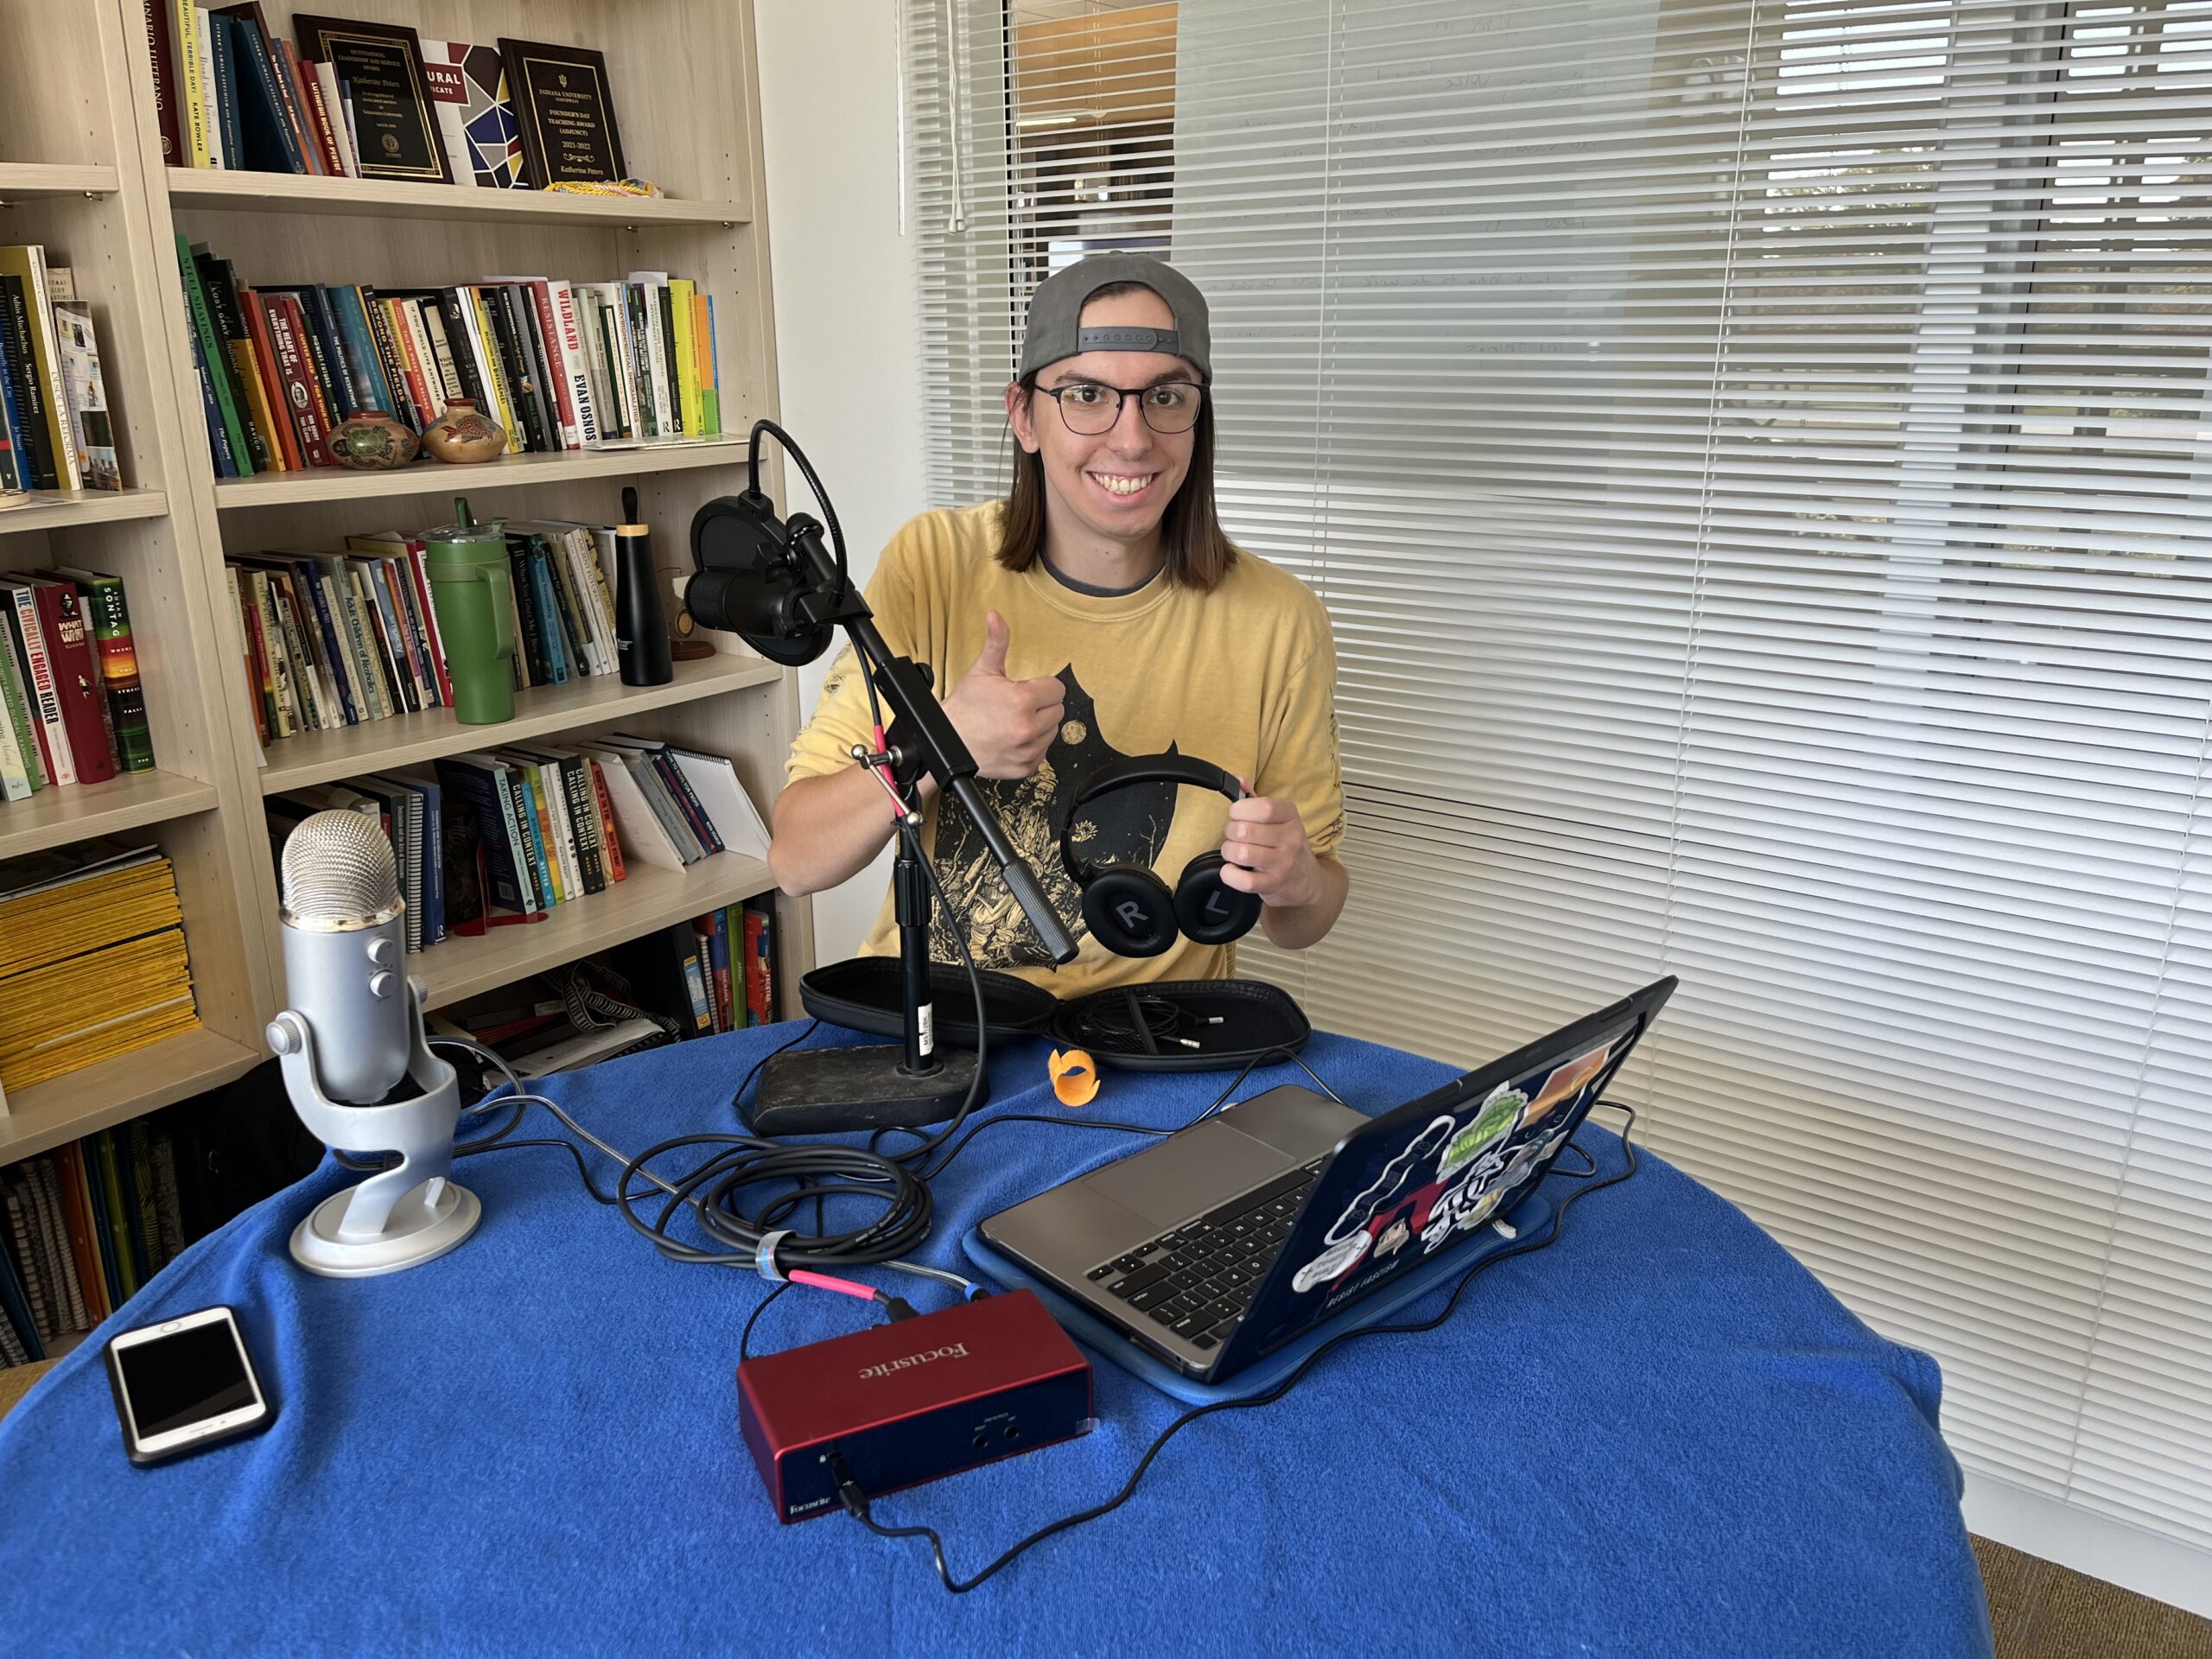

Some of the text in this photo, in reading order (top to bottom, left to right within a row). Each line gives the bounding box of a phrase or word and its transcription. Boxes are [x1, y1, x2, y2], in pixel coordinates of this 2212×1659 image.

[186, 42, 194, 73] TERRIBLE
[550, 110, 579, 118] FOUNDER'S
[562, 91, 592, 100] UNIVERSITY
[326, 135, 333, 145] OF
[548, 118, 575, 127] TEACHING
[560, 128, 588, 137] (ADJUNCT)
[562, 141, 591, 150] 2021-2022
[211, 287, 221, 309] LOST
[17, 315, 28, 353] Muchachos
[194, 296, 212, 348] SHAVINGS
[542, 298, 561, 367] RESISTANCE
[558, 289, 578, 350] WILDLAND
[269, 309, 292, 375] EVERYTHING THAT IS
[278, 317, 297, 364] THE HEART OF
[312, 334, 323, 362] MIDWEST
[371, 300, 404, 402] BEYOND THE FIELDS
[299, 333, 309, 357] CUSTER
[306, 358, 314, 374] DIED
[318, 399, 326, 417] YOUR
[336, 346, 345, 369] POLITICS
[344, 376, 357, 408] RESENTMENT
[417, 329, 426, 350] COULD
[428, 367, 440, 401] ANYWHERE
[618, 304, 630, 369] ENVIRONMENTAL
[628, 372, 638, 422] INEQUALITIES
[23, 362, 40, 414] Sergio Ramírez
[51, 371, 74, 464] DESDE LA REFORMA
[574, 374, 596, 441] EVAN OSNOS
[14, 433, 24, 451] Stuart
[249, 421, 260, 450] DAVICH
[518, 560, 527, 582] When
[577, 537, 599, 603] ANCIENT FUTURES
[102, 587, 121, 636] SONTAG
[112, 591, 123, 617] SUSAN
[257, 581, 265, 601] THE
[261, 602, 273, 642] PROPHET
[524, 598, 532, 617] Greet
[58, 620, 82, 631] WHAT
[387, 615, 403, 653] simplicity
[527, 619, 535, 631] Me
[16, 590, 58, 724] THE CIVICALLY ENGAGED READER
[344, 596, 376, 693] Adult Children of Alcoholics
[275, 677, 284, 702] GIBRAN
[665, 750, 674, 763] HOW
[671, 762, 678, 770] TO
[676, 769, 685, 783] BLOG
[688, 791, 699, 808] PROFIT
[498, 778, 520, 846] TAKING ACTION
[512, 784, 526, 818] CALLING
[566, 770, 589, 850] CALLING IN CONTEXT
[575, 768, 597, 848] CALLING IN CONTEXT
[520, 820, 528, 829] IN
[522, 831, 535, 866] CONTEXT
[530, 817, 549, 887] DOING GOOD BETTER
[1115, 900, 1149, 929] R
[1205, 891, 1229, 915] L
[1326, 1283, 1360, 1309] RESIST
[1361, 1259, 1400, 1287] FASCISM
[859, 1342, 970, 1380] Focusrite
